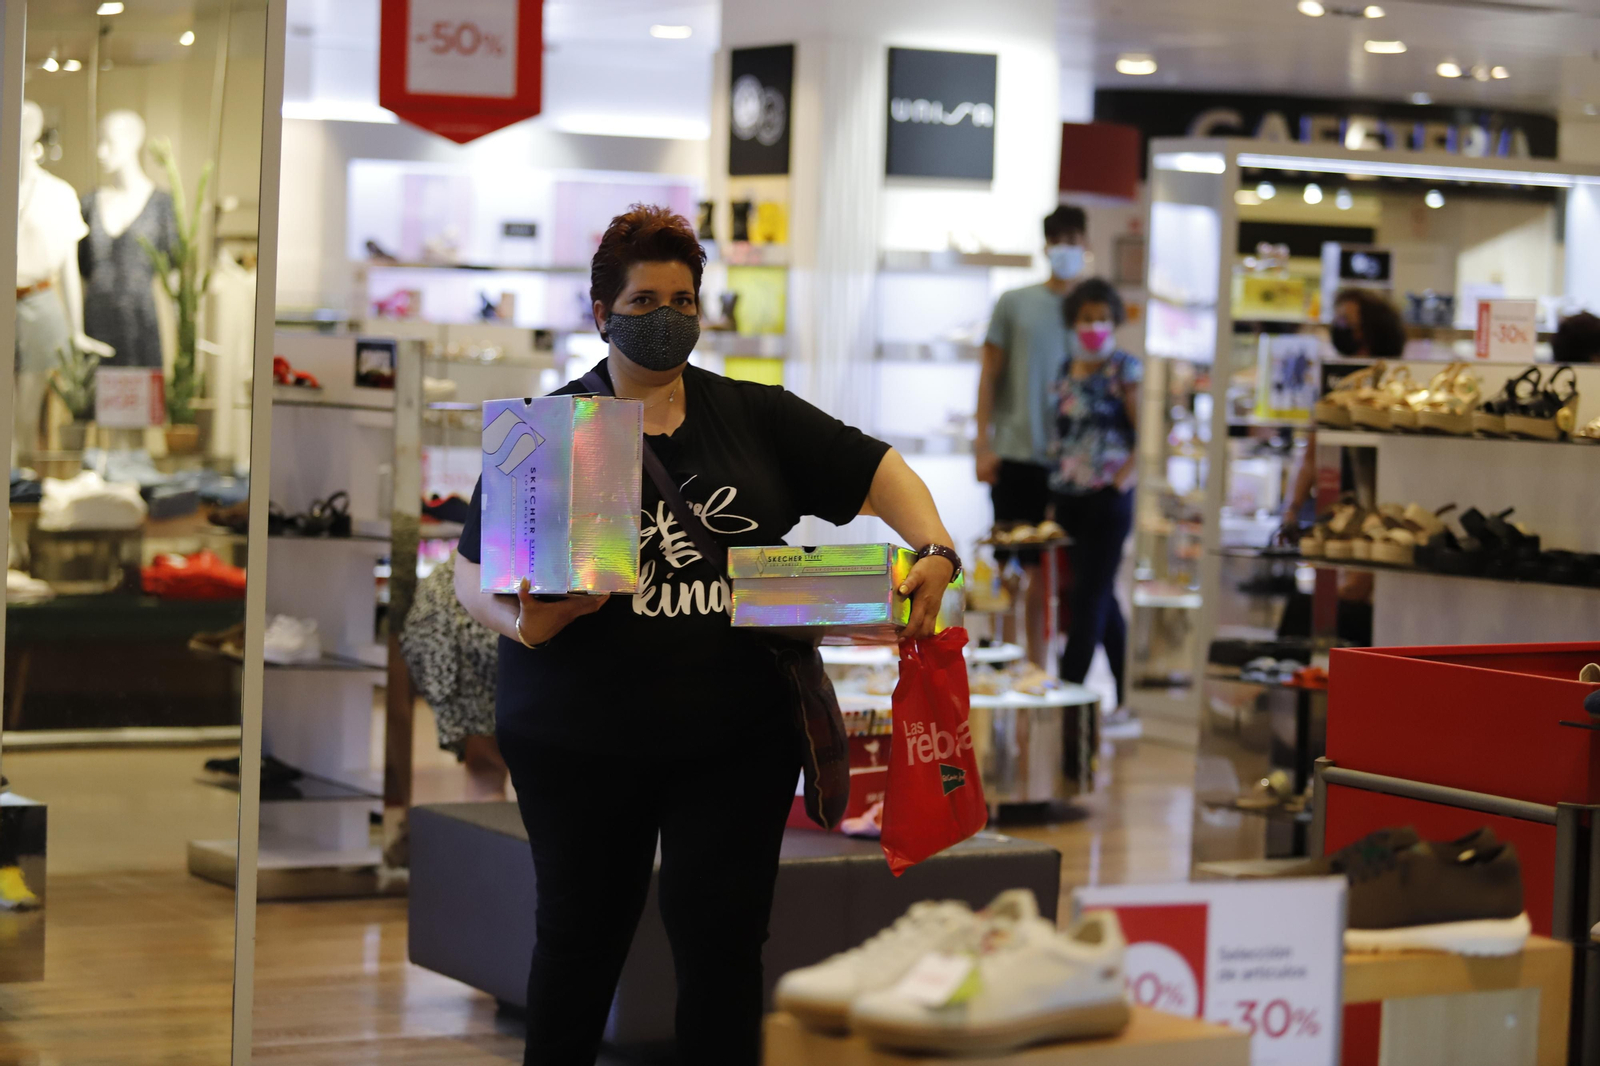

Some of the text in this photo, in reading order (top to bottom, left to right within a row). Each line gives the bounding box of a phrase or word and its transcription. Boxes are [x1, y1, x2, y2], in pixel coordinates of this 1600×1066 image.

[415, 21, 505, 57] -50%
[767, 555, 803, 563] SKECHER
[903, 720, 925, 737] Las
[1124, 971, 1187, 1009] 0%
